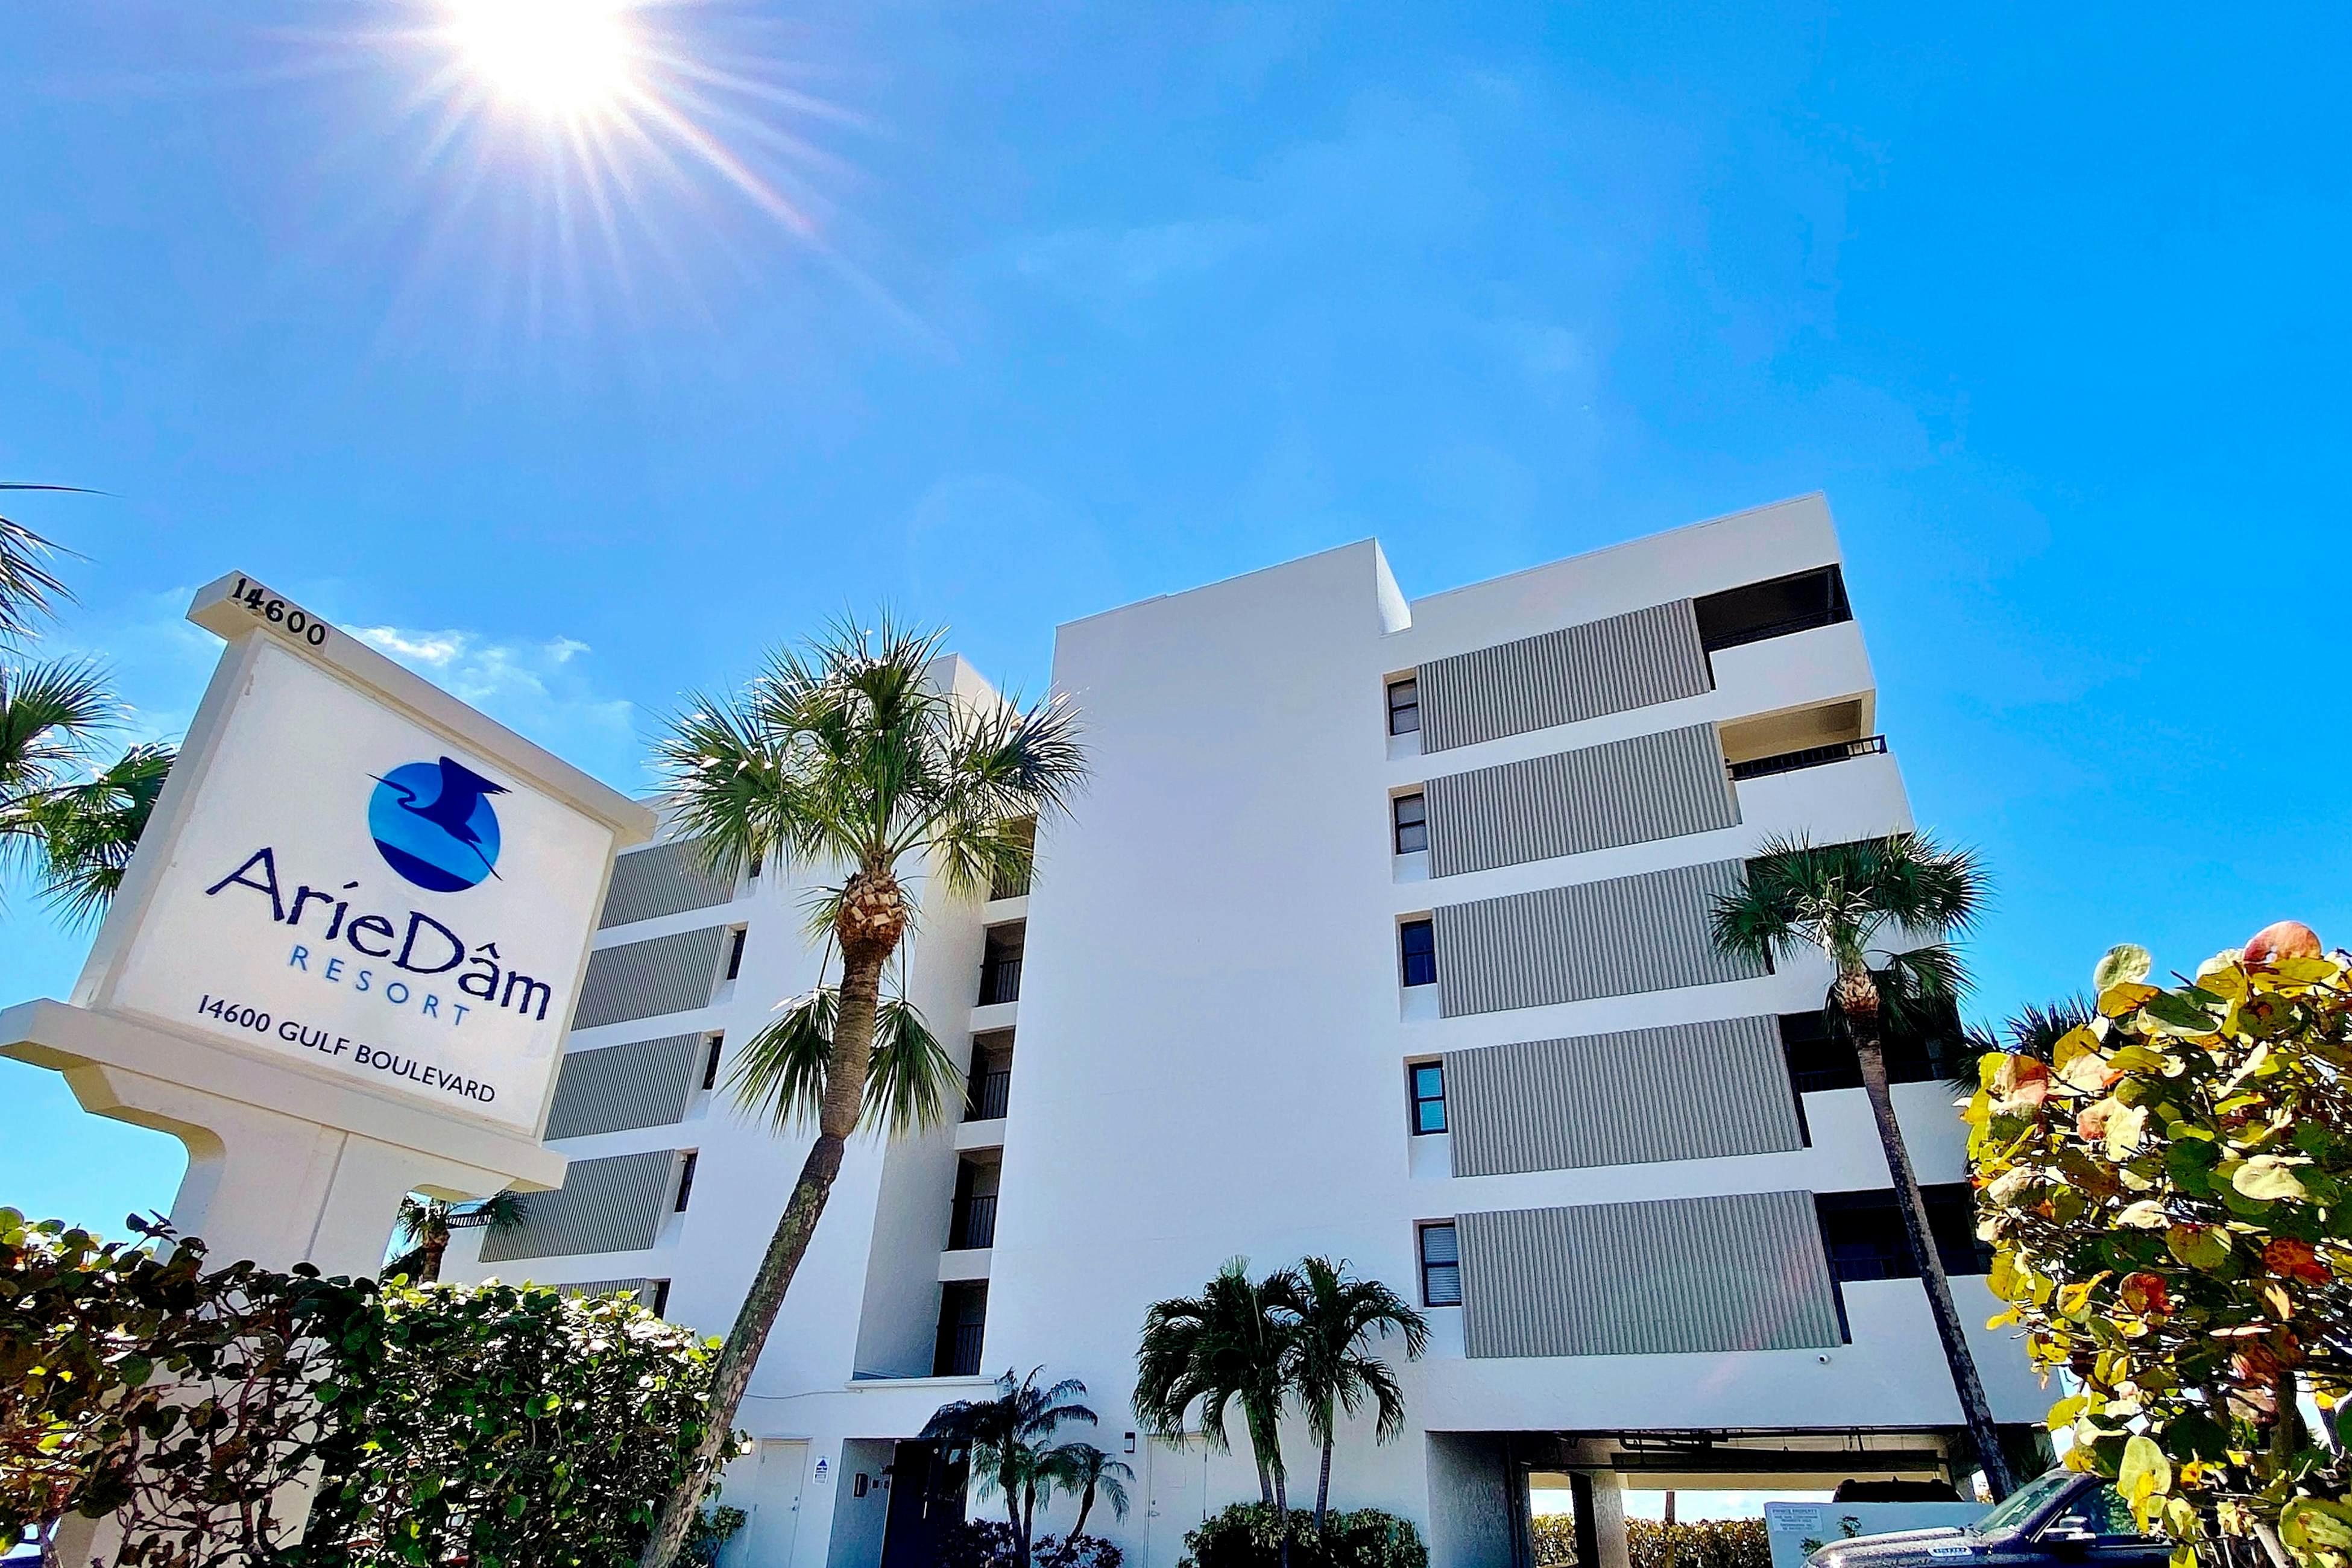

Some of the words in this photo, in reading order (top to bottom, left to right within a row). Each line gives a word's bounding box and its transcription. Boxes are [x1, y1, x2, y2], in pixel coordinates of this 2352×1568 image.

[232, 577, 326, 646] 14600
[289, 945, 470, 1026] RESORT
[197, 994, 271, 1033] 14600
[278, 1021, 350, 1056] GULF
[355, 1044, 496, 1105] BOULEVARD
